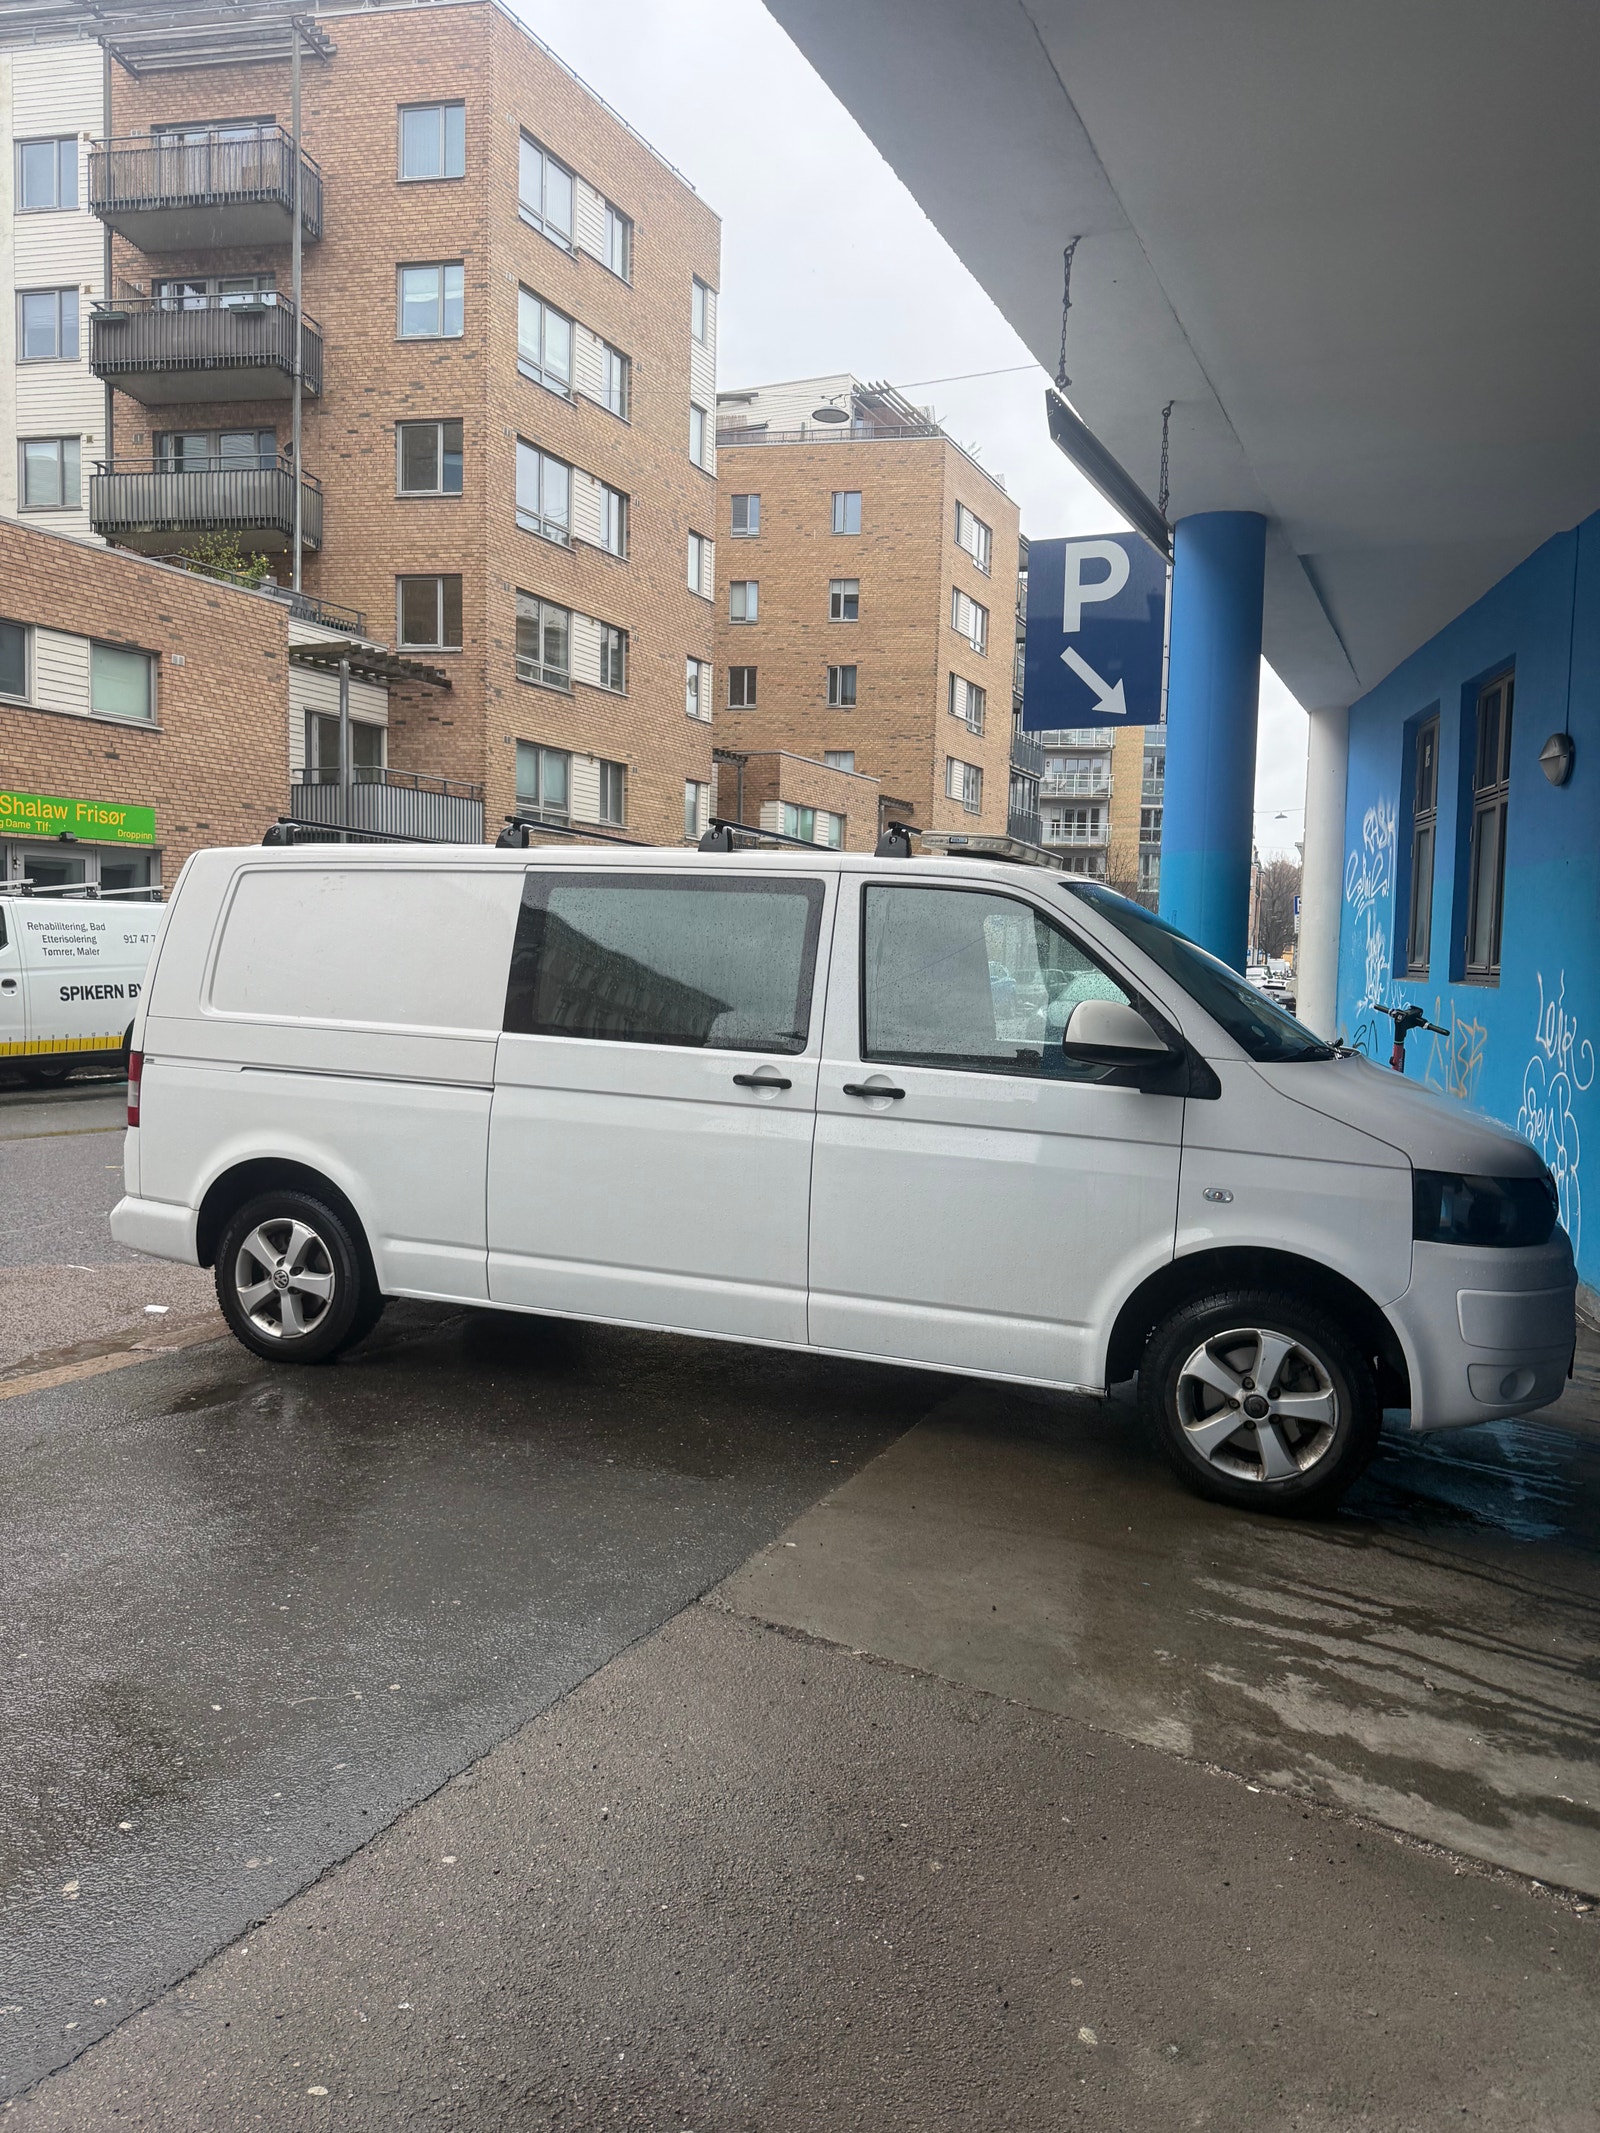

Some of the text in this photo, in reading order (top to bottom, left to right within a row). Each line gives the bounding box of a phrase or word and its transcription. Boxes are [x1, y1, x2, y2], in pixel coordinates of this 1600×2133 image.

[1063, 539, 1130, 633] P
[0, 794, 126, 825] Shalaw Frisør
[6, 818, 30, 829] Dame
[27, 921, 106, 932] Rehabilitering, Bad
[42, 934, 97, 945] Etterisolering
[123, 934, 137, 944] 917
[140, 934, 149, 944] 47
[77, 947, 100, 956] Maler
[60, 984, 124, 1001] SPIKERN
